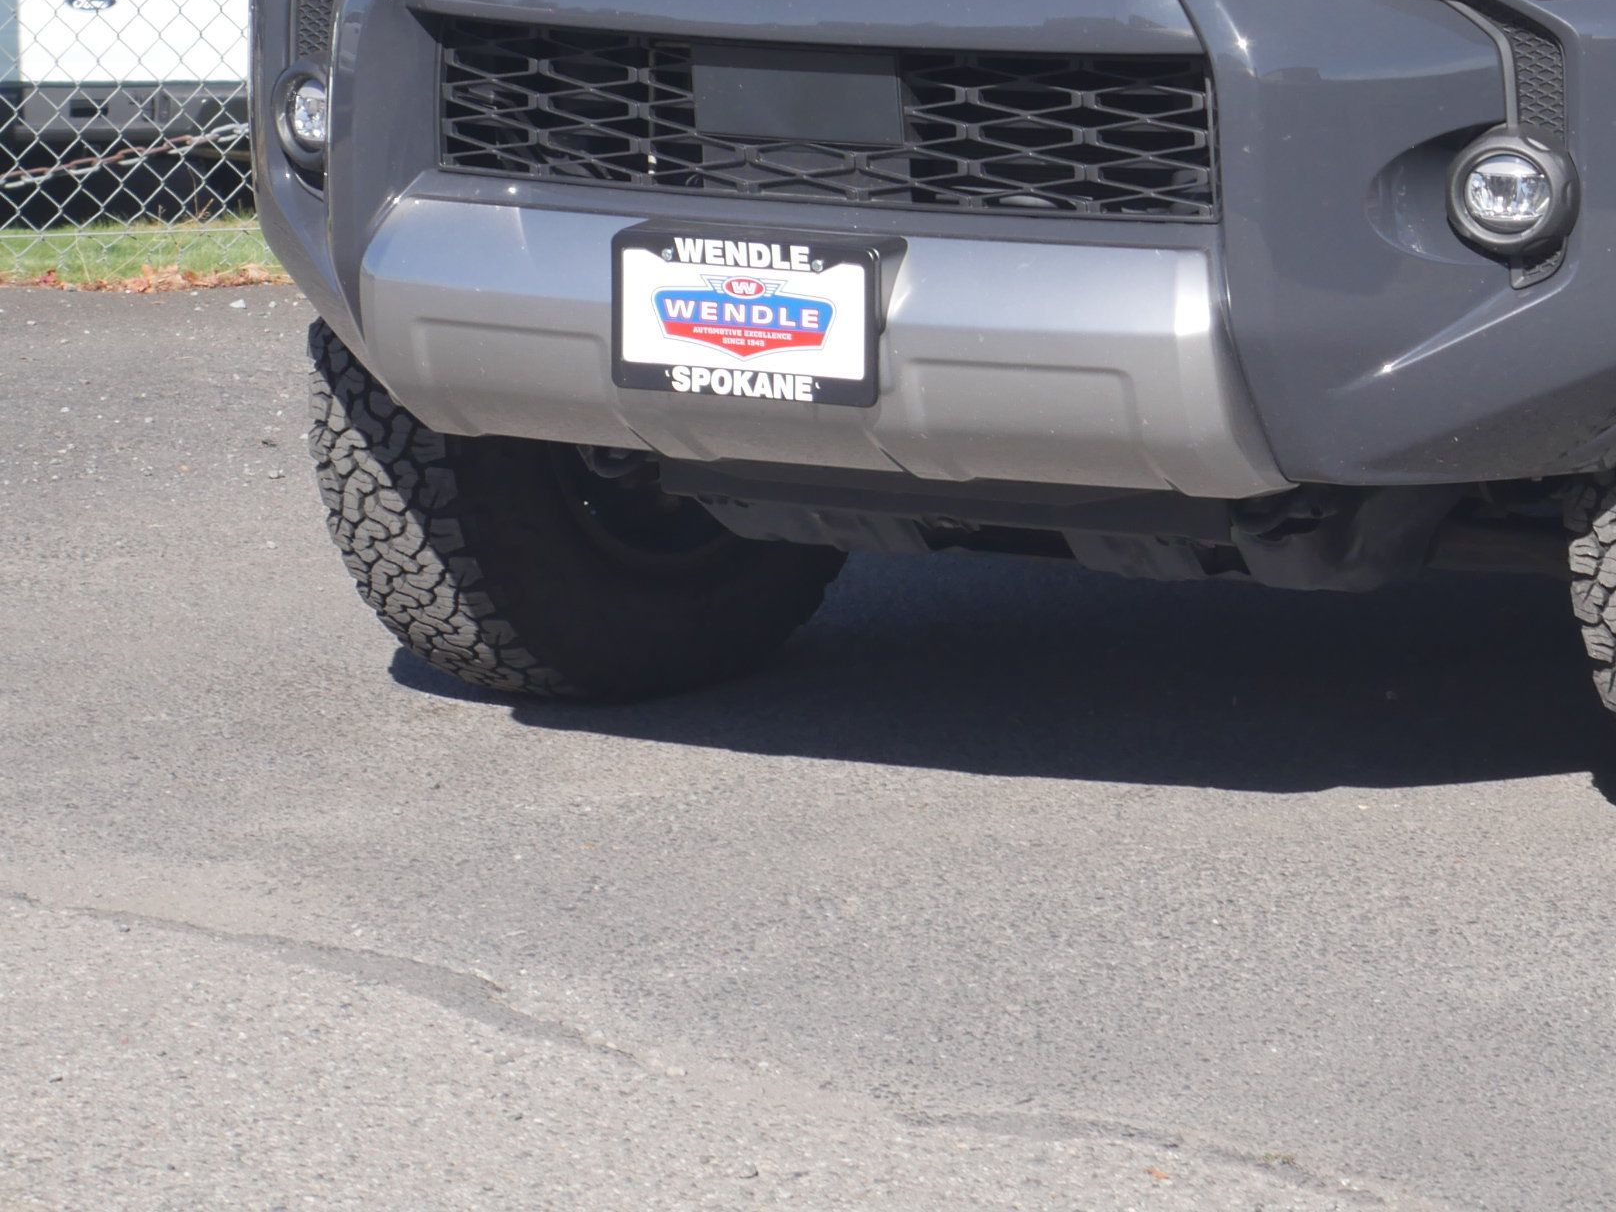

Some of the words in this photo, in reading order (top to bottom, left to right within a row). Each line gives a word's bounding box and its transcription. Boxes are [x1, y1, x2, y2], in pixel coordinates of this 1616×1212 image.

[674, 237, 812, 272] WENDLE
[664, 298, 819, 329] WENDLE
[693, 326, 743, 337] AUTOMOTIVE
[744, 330, 793, 341] EXCELLENCE
[722, 337, 746, 346] SINCE
[671, 365, 813, 401] SPOKANE
